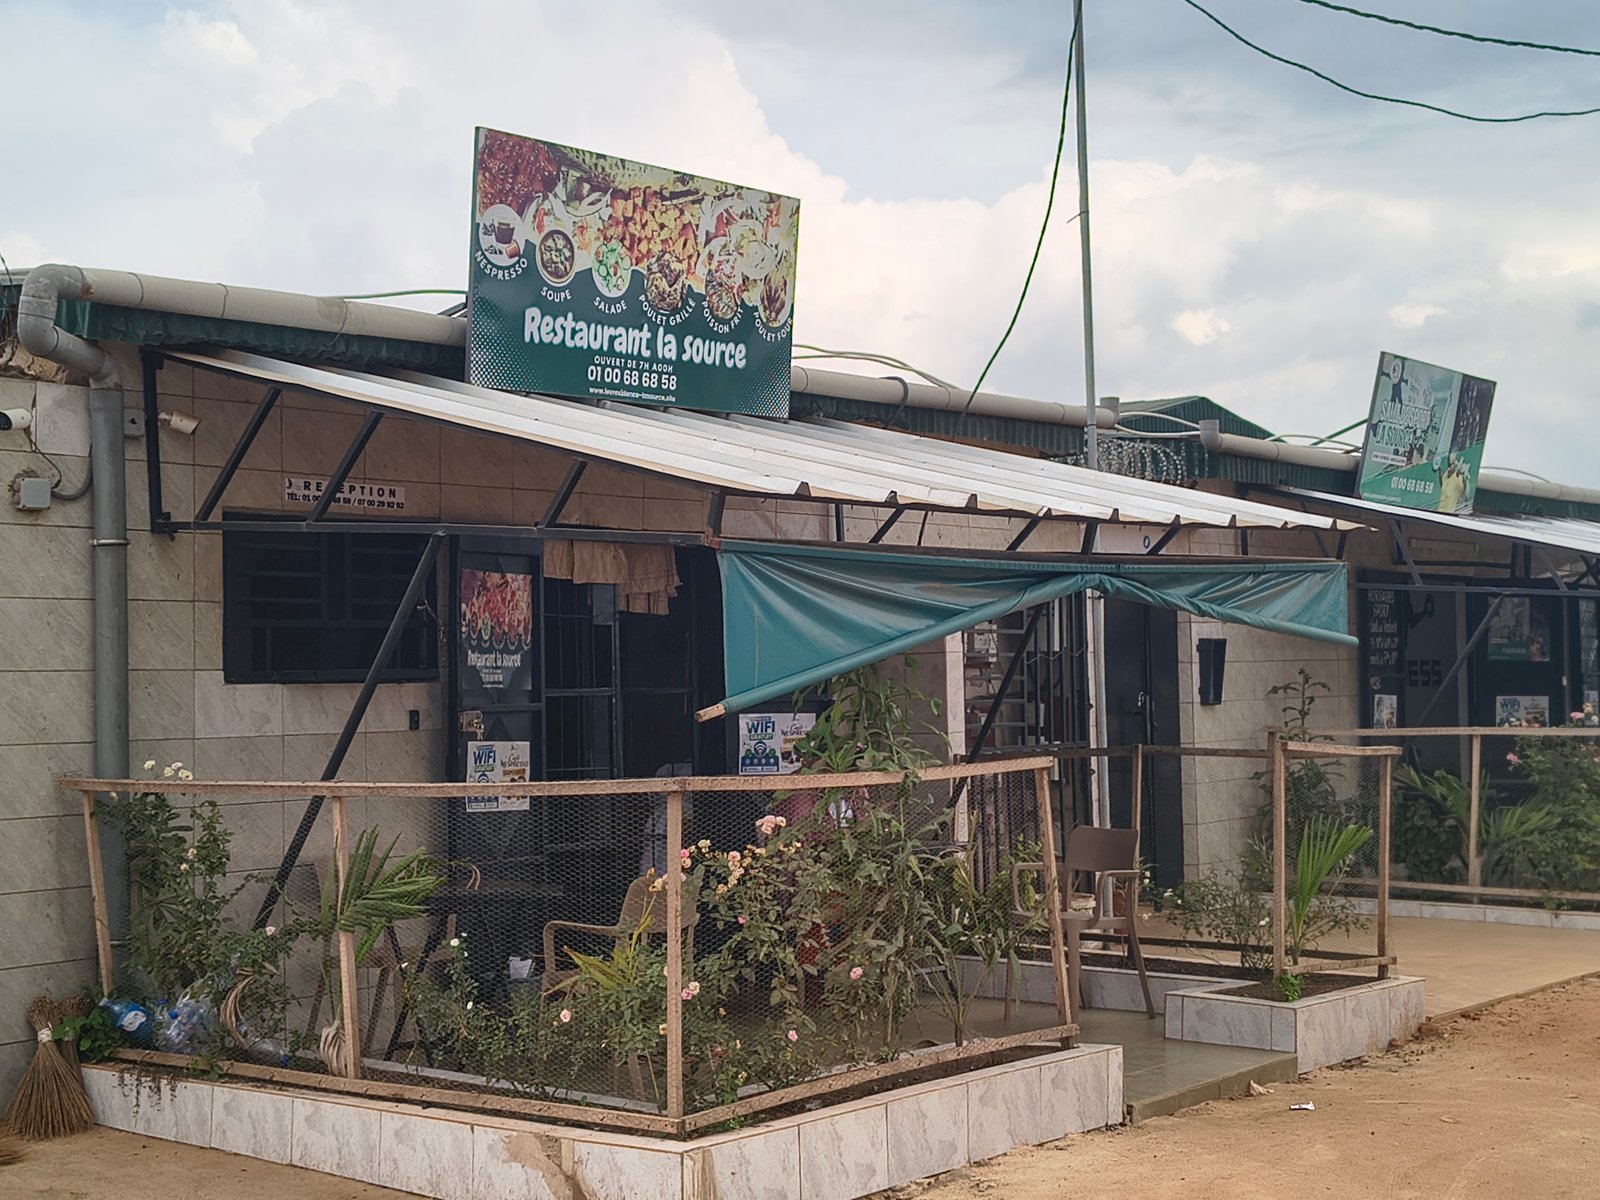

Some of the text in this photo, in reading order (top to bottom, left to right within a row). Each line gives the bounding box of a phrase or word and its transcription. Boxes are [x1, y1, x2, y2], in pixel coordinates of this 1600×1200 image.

[475, 250, 528, 280] NESPRESSO
[540, 286, 572, 302] SOUPE
[593, 296, 627, 314] SALADE
[638, 294, 667, 326] POULET
[701, 301, 744, 334] POISSON FRIT
[753, 311, 793, 342] POULET FOUR
[524, 307, 747, 369] Restaurant la source
[594, 355, 625, 367] OUVERT
[627, 359, 637, 369] DE
[639, 361, 649, 370] 7H
[587, 365, 677, 390] 01 00 68 68 58
[303, 480, 396, 498] REEPTION
[357, 498, 366, 506] 07
[367, 499, 375, 507] 00
[1500, 700, 1520, 709] WIFI
[746, 721, 775, 733] WIFI
[473, 750, 496, 765] WIFI
